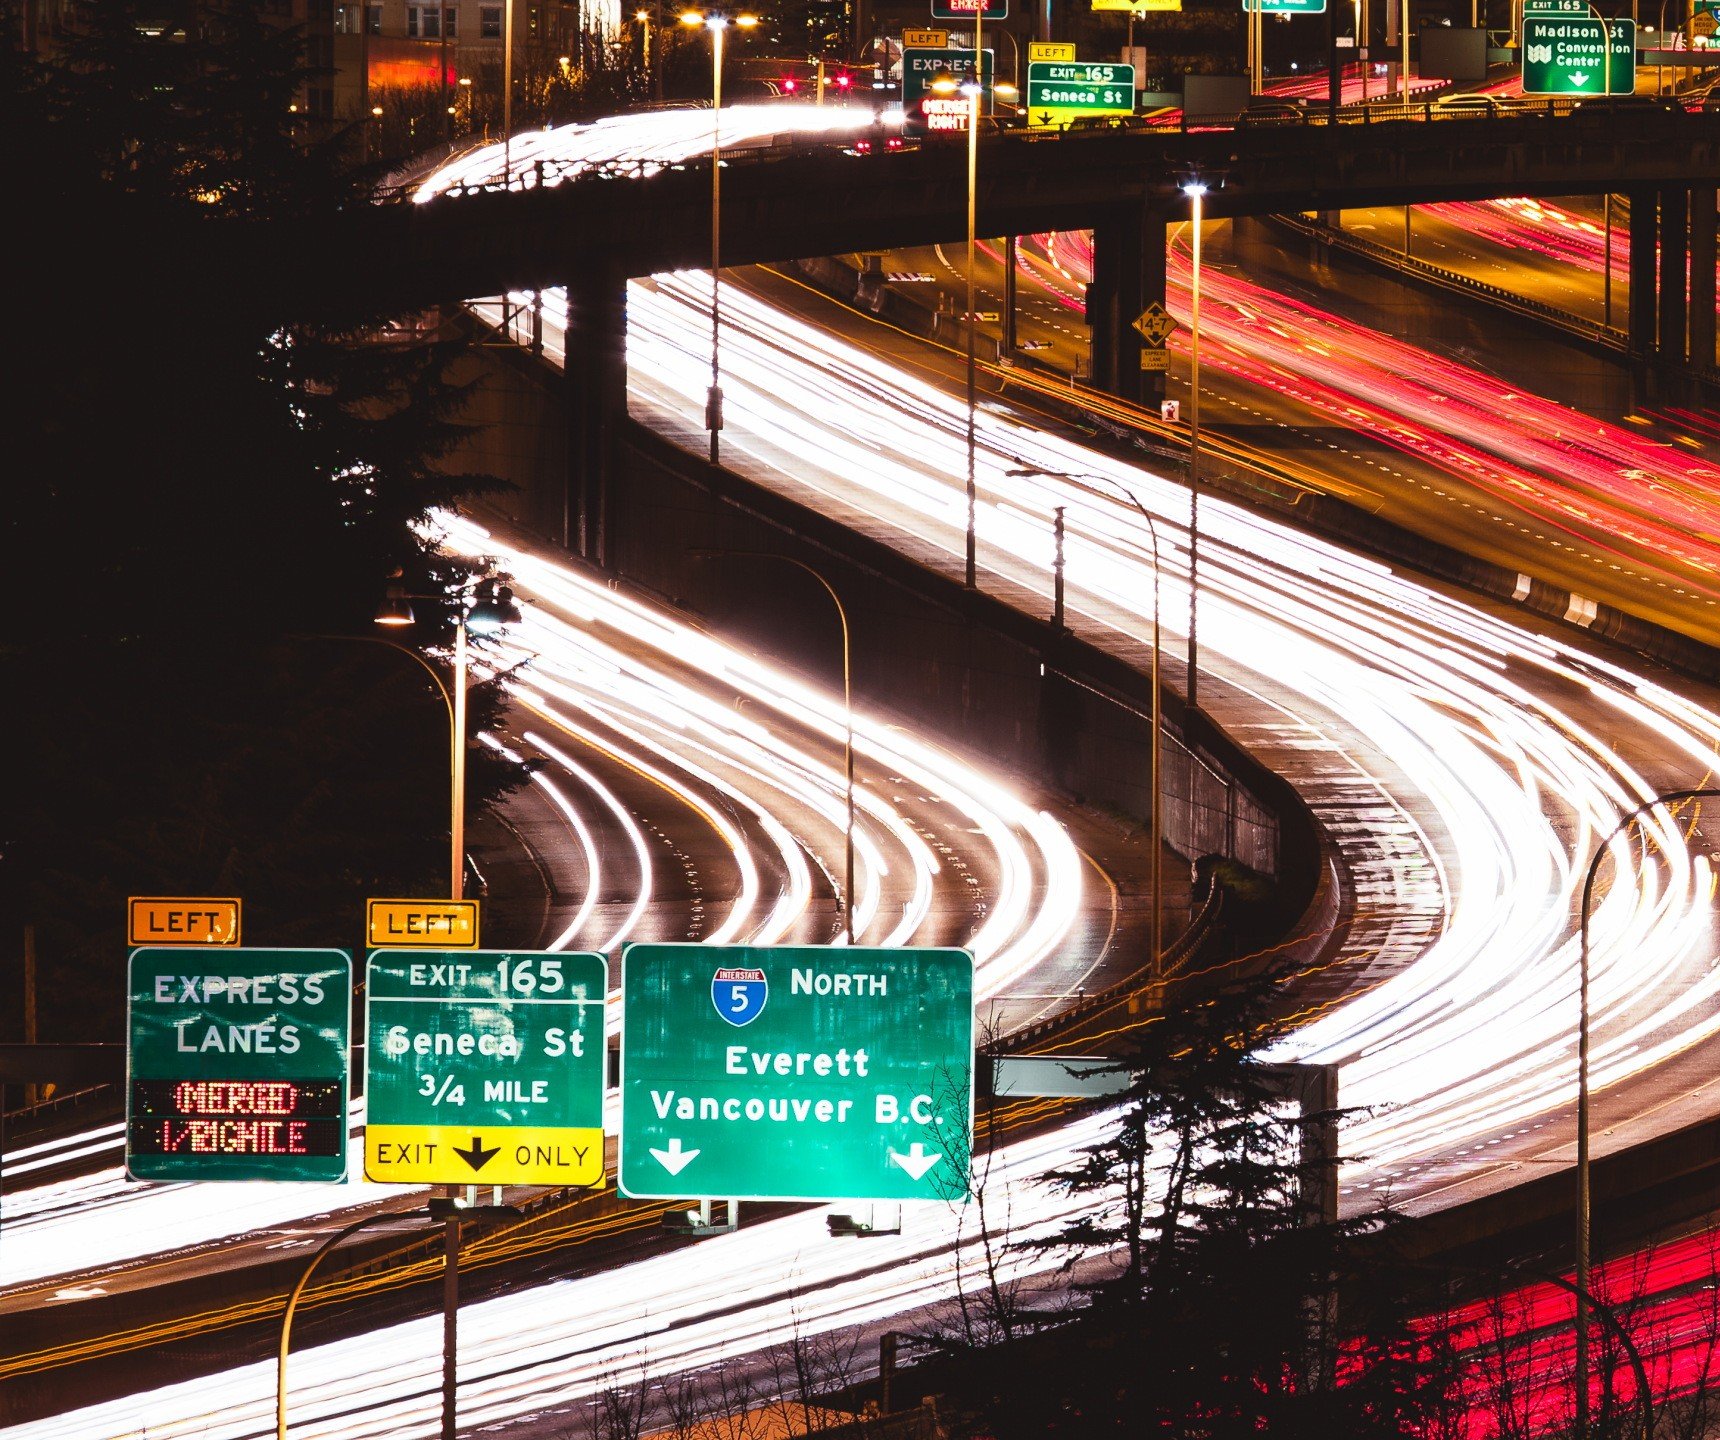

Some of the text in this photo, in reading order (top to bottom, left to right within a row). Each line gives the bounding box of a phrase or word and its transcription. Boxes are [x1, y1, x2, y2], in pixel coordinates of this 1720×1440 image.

[1532, 0, 1580, 10] EXIT 165
[910, 34, 940, 43] LEFT
[1534, 25, 1624, 39] Madison St
[1037, 48, 1066, 57] LEFT
[1556, 42, 1631, 53] Convenion
[1556, 55, 1601, 67] Center
[1049, 67, 1114, 81] EXIT 165
[1041, 88, 1122, 104] Seneca St
[150, 911, 219, 933] LEFT
[388, 913, 458, 935] LEFT
[410, 960, 565, 993] EXIT 165
[719, 969, 761, 980] INTERSTATE
[790, 968, 888, 997] NORTH
[154, 975, 325, 1005] EXPRESS
[730, 985, 749, 1013] 5
[177, 1025, 301, 1054] LANES
[387, 1025, 585, 1058] Seneca St
[725, 1045, 870, 1078] Everett
[418, 1074, 550, 1106] 3/4 MILE
[650, 1090, 944, 1126] Vancouver B.C.
[377, 1143, 590, 1167] EXIT ONLY
